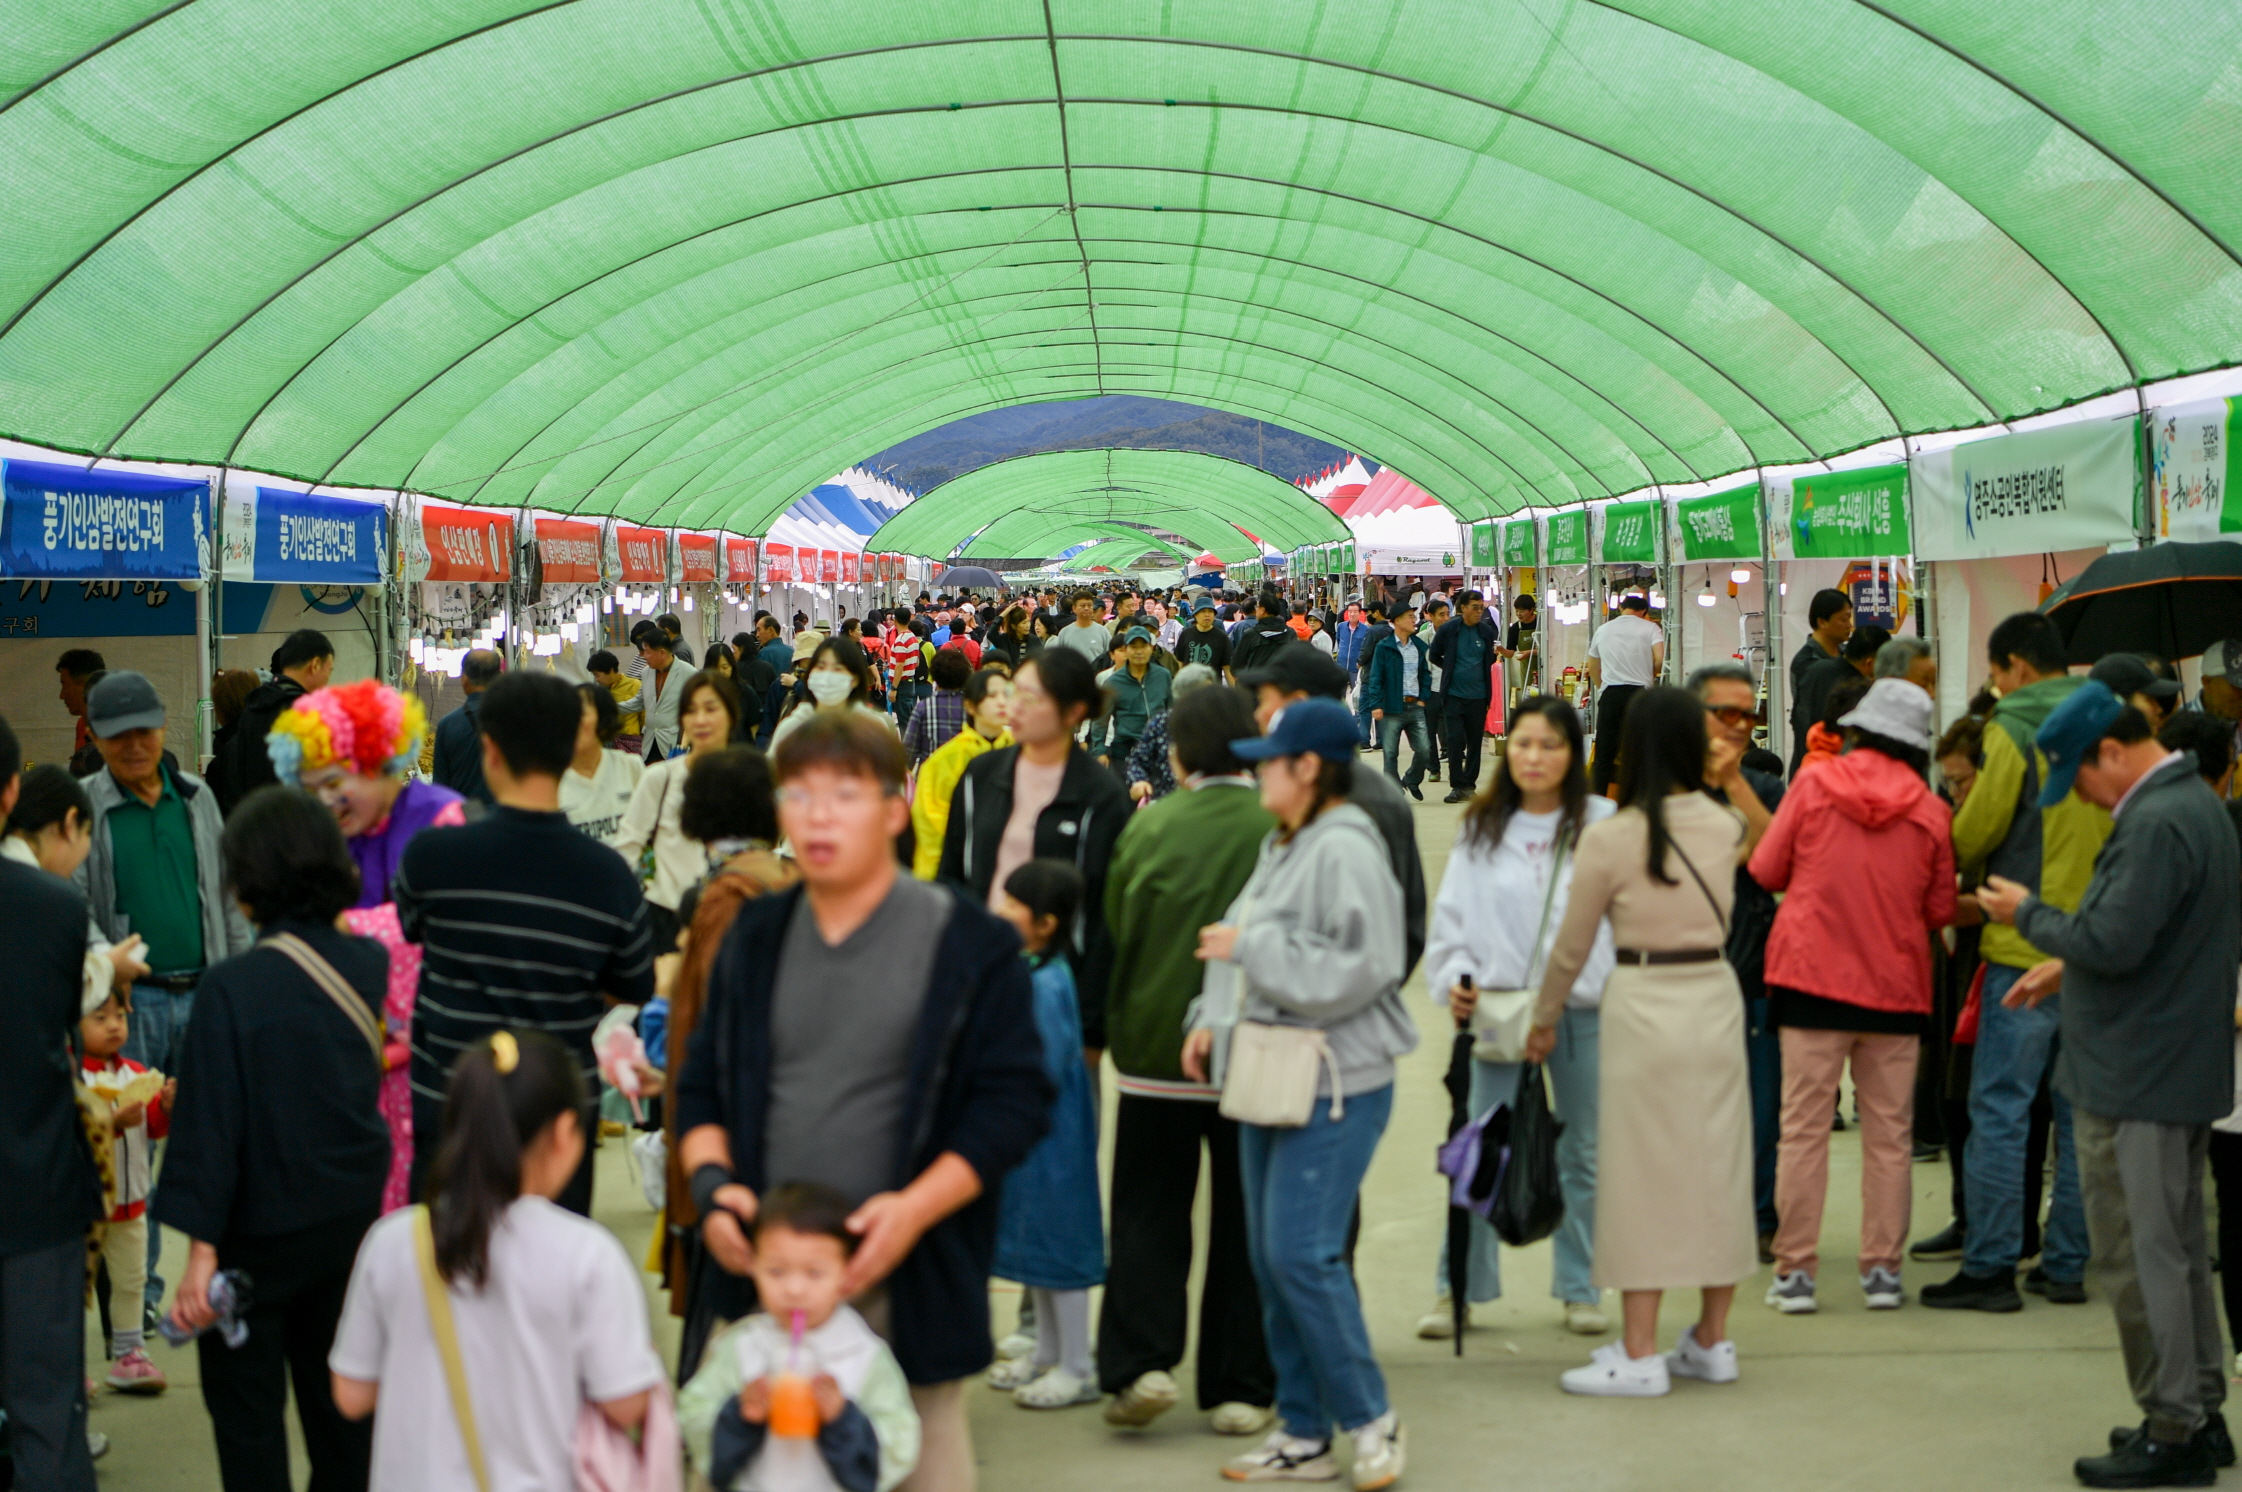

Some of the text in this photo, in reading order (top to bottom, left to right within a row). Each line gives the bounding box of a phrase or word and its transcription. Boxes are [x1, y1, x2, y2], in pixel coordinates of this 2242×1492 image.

[2202, 424, 2218, 445] 2024
[1837, 490, 1871, 536] 주식회사
[1974, 464, 2067, 521] 영주소공인복합지원센터
[43, 491, 164, 552] 풍기인삼발전연구회
[279, 514, 356, 563] 풍기인삼발전연구회
[440, 524, 485, 567] 인삼판매장
[0, 615, 39, 636] 구회
